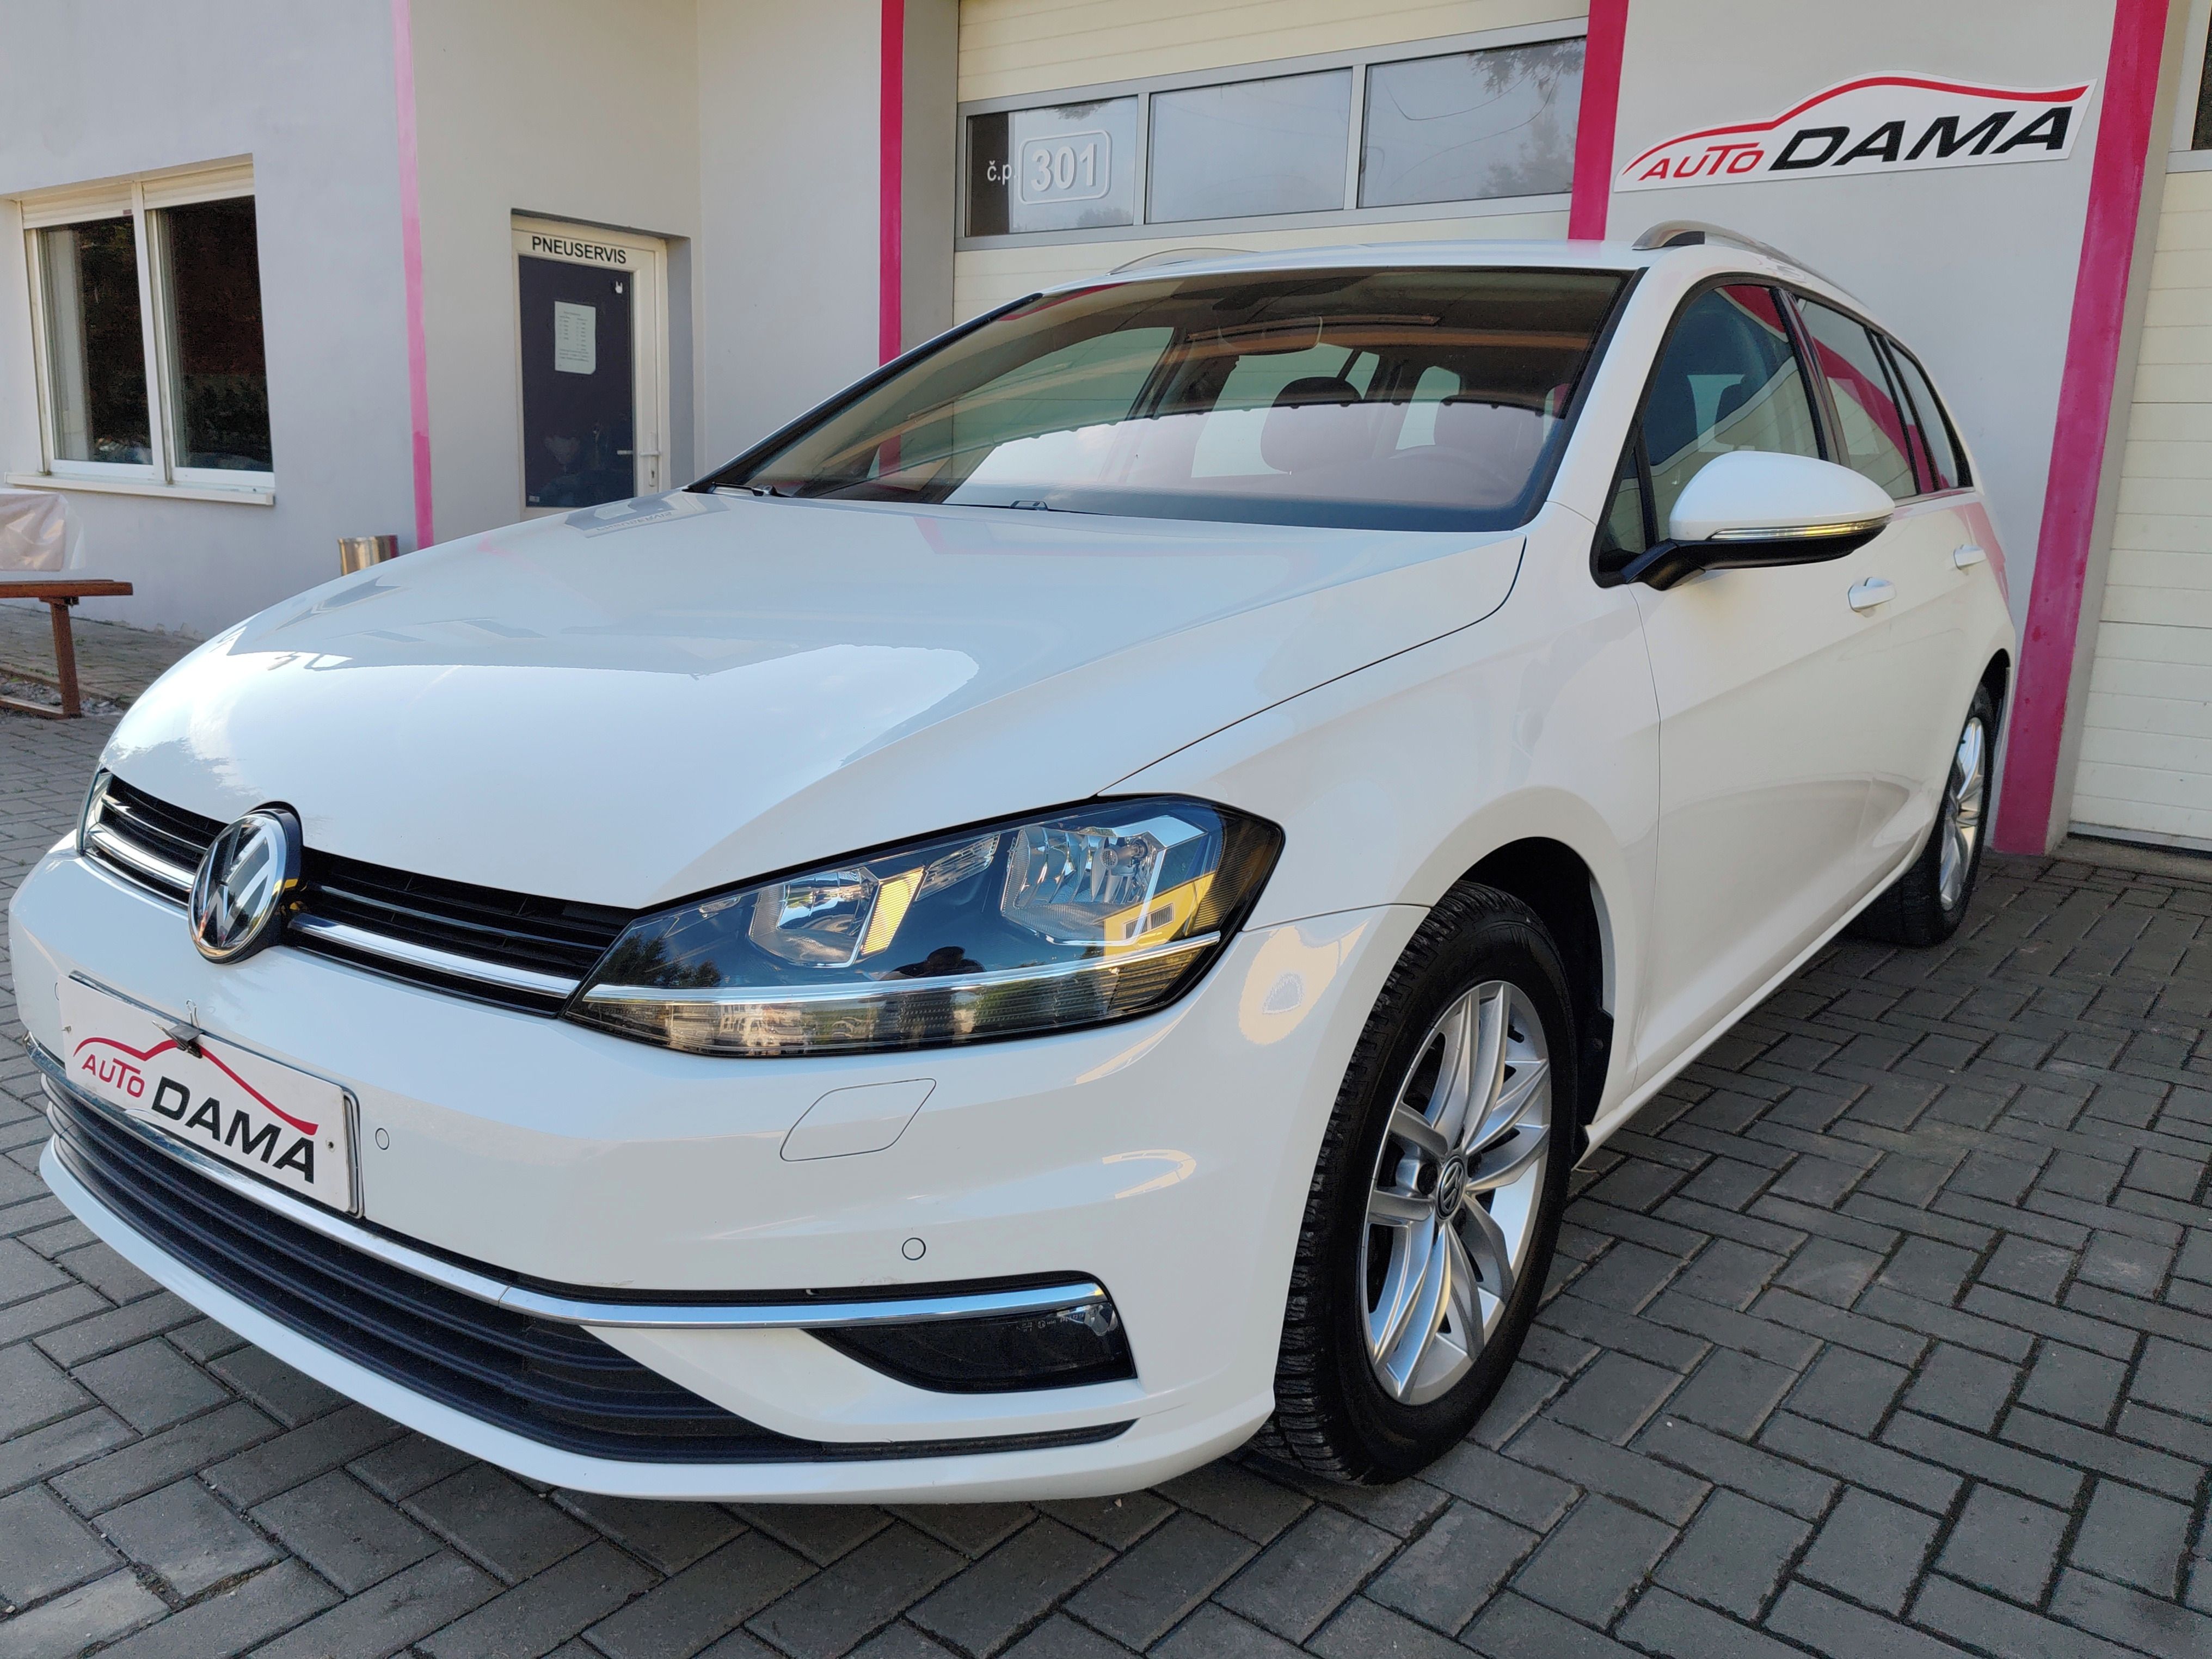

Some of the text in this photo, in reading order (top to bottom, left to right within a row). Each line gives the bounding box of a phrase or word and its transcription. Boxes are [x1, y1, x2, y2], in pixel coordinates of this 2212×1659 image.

[1031, 143, 1097, 191] 301
[1637, 106, 2072, 181] AUTO DAMA
[532, 236, 626, 264] PNEUSERVIS
[82, 1054, 314, 1184] AUTO DAMA
